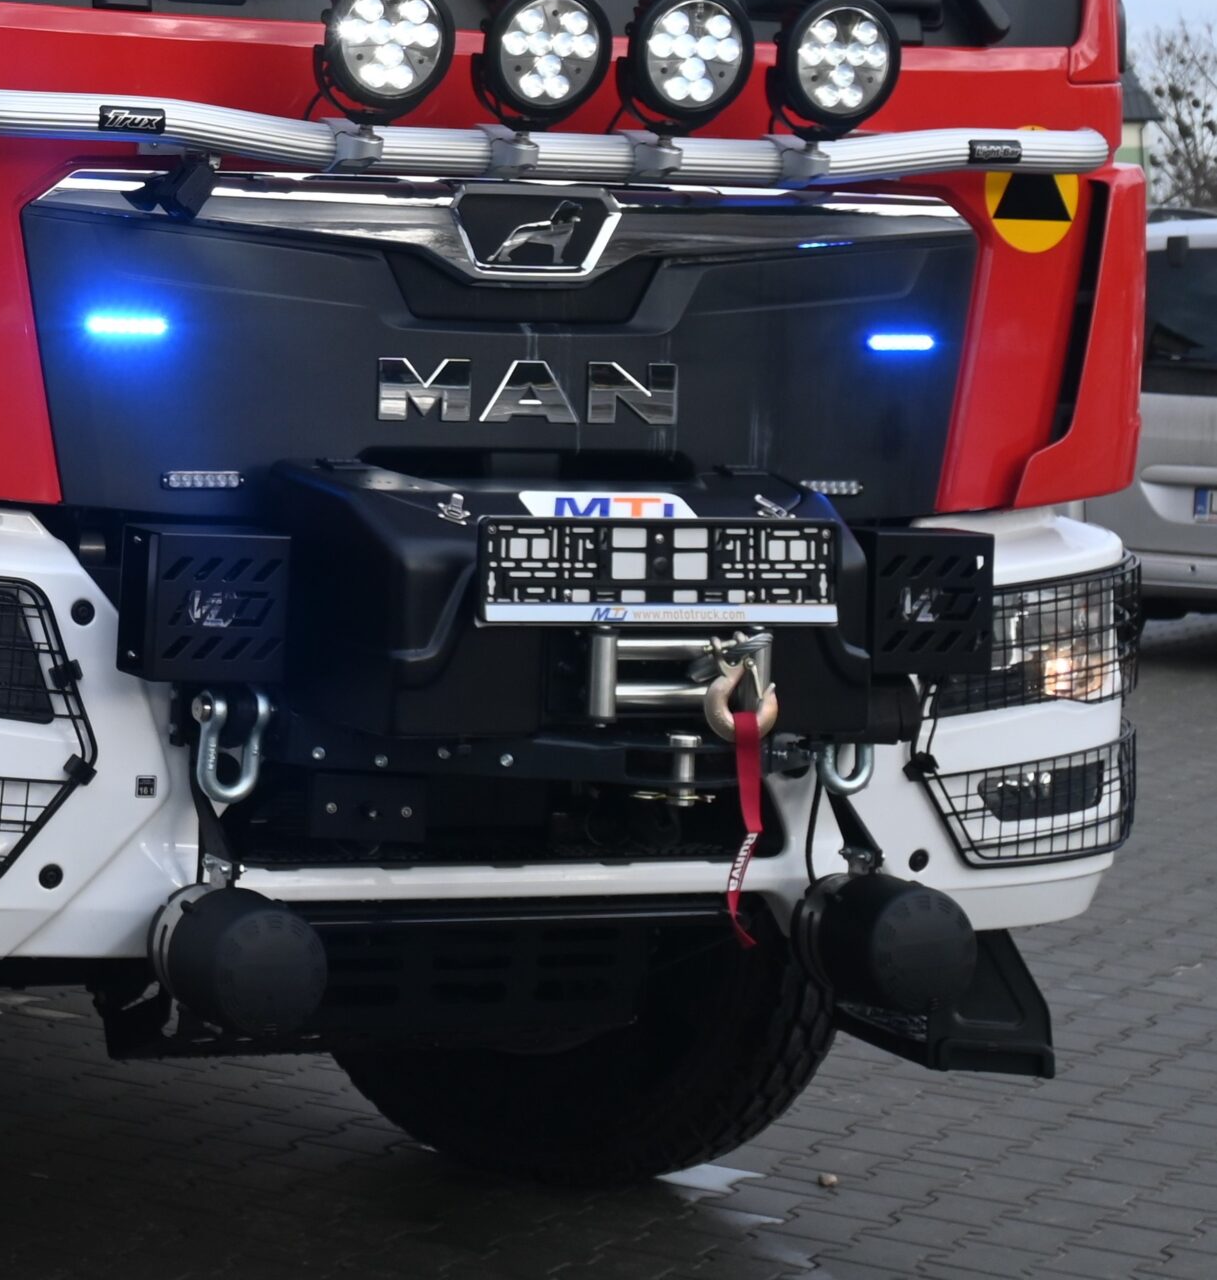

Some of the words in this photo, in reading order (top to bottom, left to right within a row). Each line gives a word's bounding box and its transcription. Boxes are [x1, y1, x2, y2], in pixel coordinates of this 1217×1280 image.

[105, 109, 164, 130] Trux
[378, 357, 678, 424] MAN
[633, 608, 747, 621] www.mototruck.com
